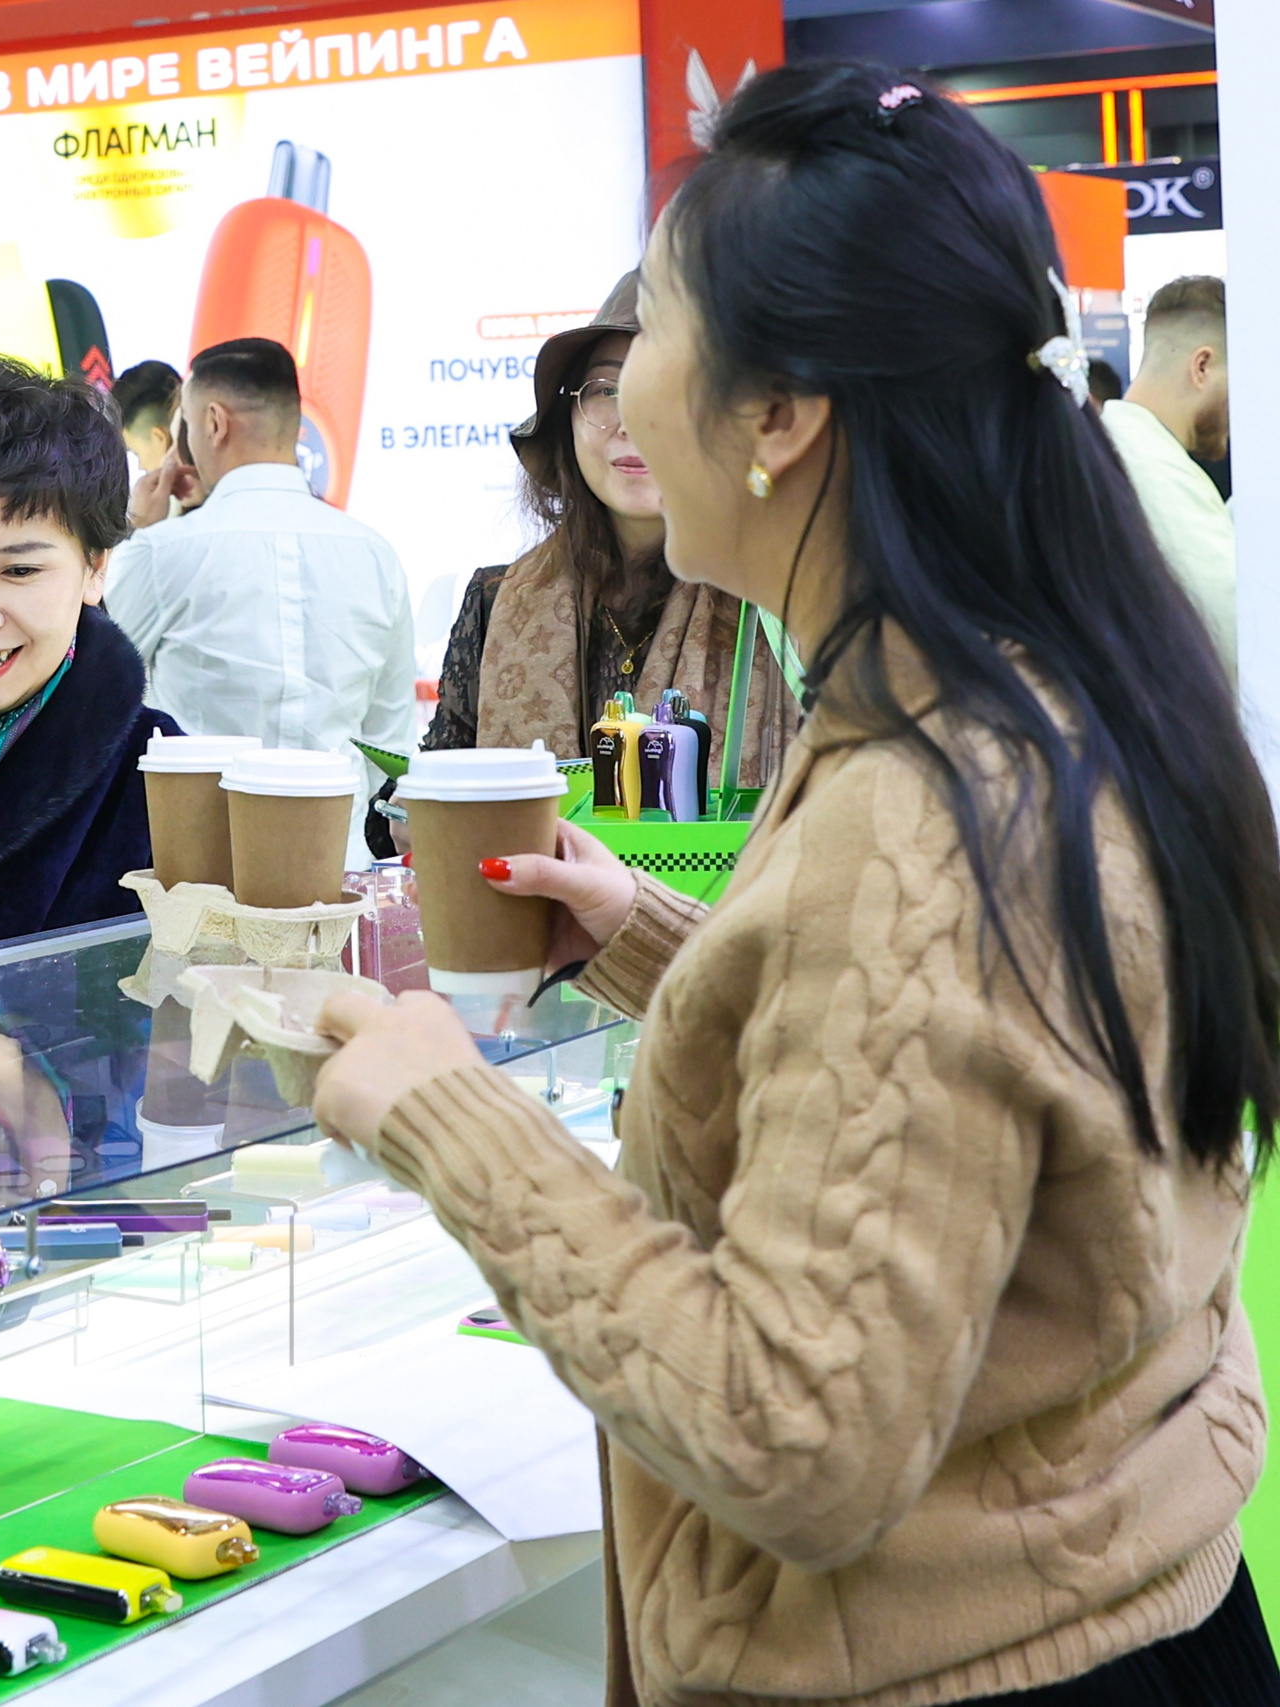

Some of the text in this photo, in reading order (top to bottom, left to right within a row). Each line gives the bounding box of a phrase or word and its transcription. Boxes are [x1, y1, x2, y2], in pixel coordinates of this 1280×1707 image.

[26, 53, 180, 108] МИРЕ
[196, 17, 527, 91] ВЕЙПИНГА
[53, 118, 216, 158] ФЛАГМАН
[381, 426, 396, 450] В
